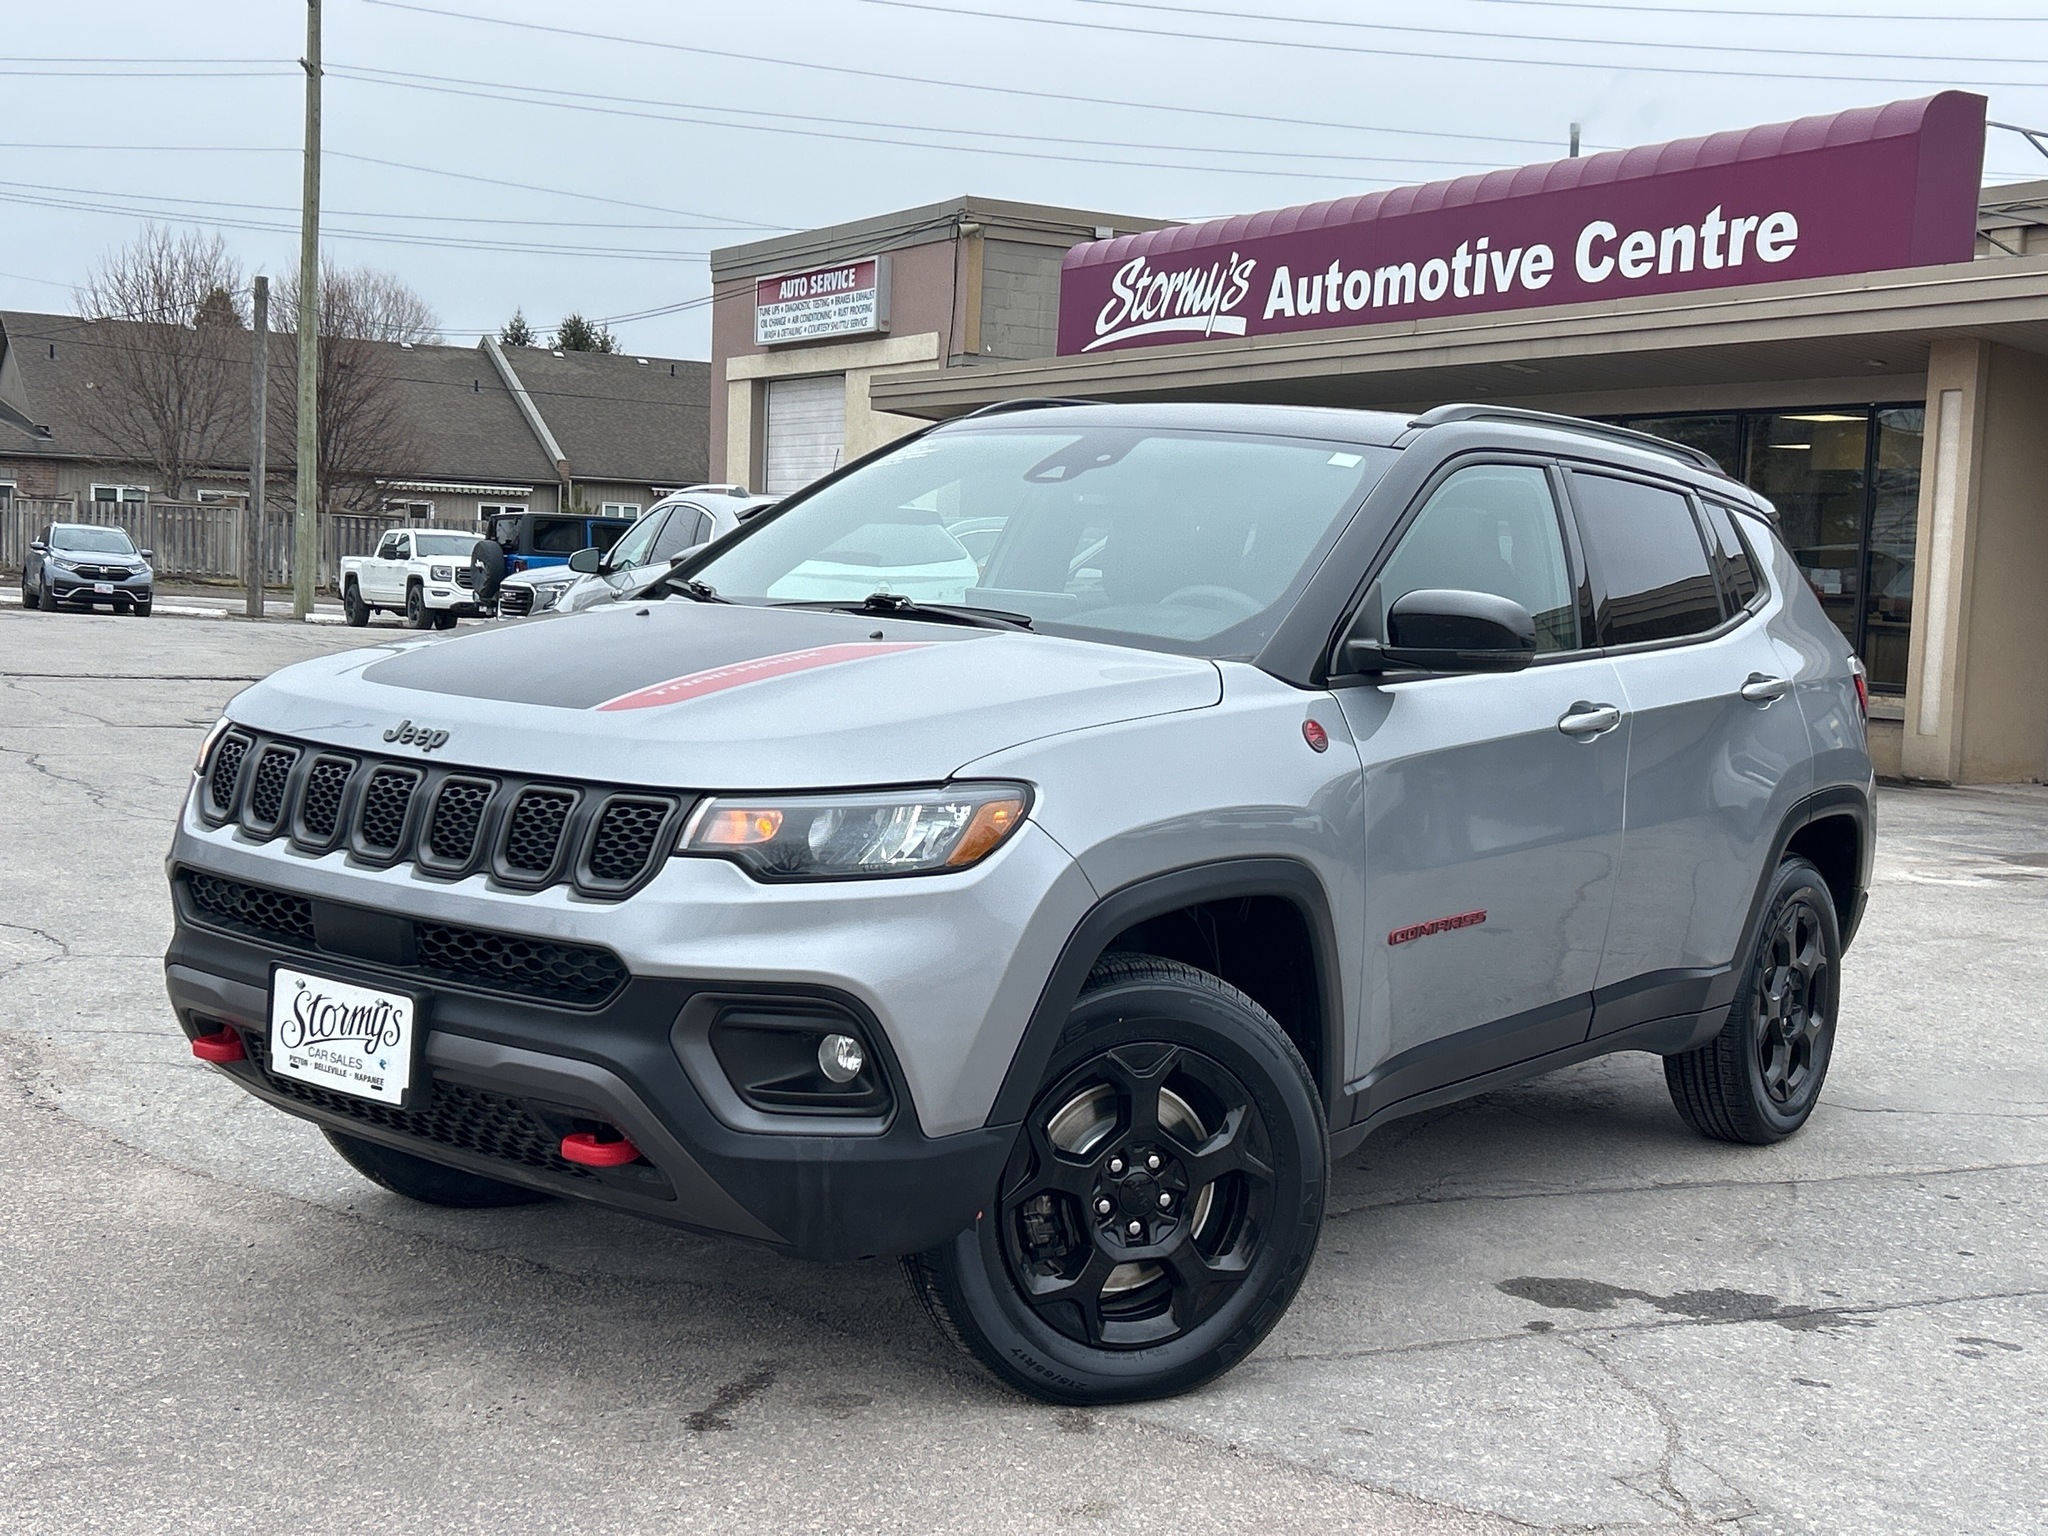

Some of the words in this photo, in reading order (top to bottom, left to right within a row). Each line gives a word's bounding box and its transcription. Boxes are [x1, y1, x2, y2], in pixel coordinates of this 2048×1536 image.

[779, 277, 807, 299] AUTO
[810, 268, 856, 295] SERVICE
[1092, 251, 1257, 342] Stormy's
[1263, 236, 1554, 320] Automotive
[1575, 204, 1799, 283] Centre
[759, 307, 771, 317] TUNE
[772, 306, 780, 315] UPS
[785, 301, 811, 313] DIAGNOSTIC
[835, 294, 851, 305] BRAKES
[760, 319, 768, 328] OIL
[769, 316, 786, 327] CHANGE
[791, 315, 799, 324] AIR
[800, 311, 832, 323] CONDITIONING
[838, 307, 849, 317] RUST
[781, 326, 802, 337] DETAILING
[808, 323, 830, 334] COURTESY
[850, 317, 868, 328] SERVICE
[383, 720, 450, 752] Jeep
[1388, 909, 1487, 946] COMPASS
[280, 990, 403, 1055] Stormy's
[289, 1054, 309, 1067] PICTON
[313, 1062, 347, 1078] BELLEVILLE
[354, 1072, 385, 1087] NAPANEE
[308, 1046, 329, 1061] CAR
[329, 1052, 363, 1070] SALES
